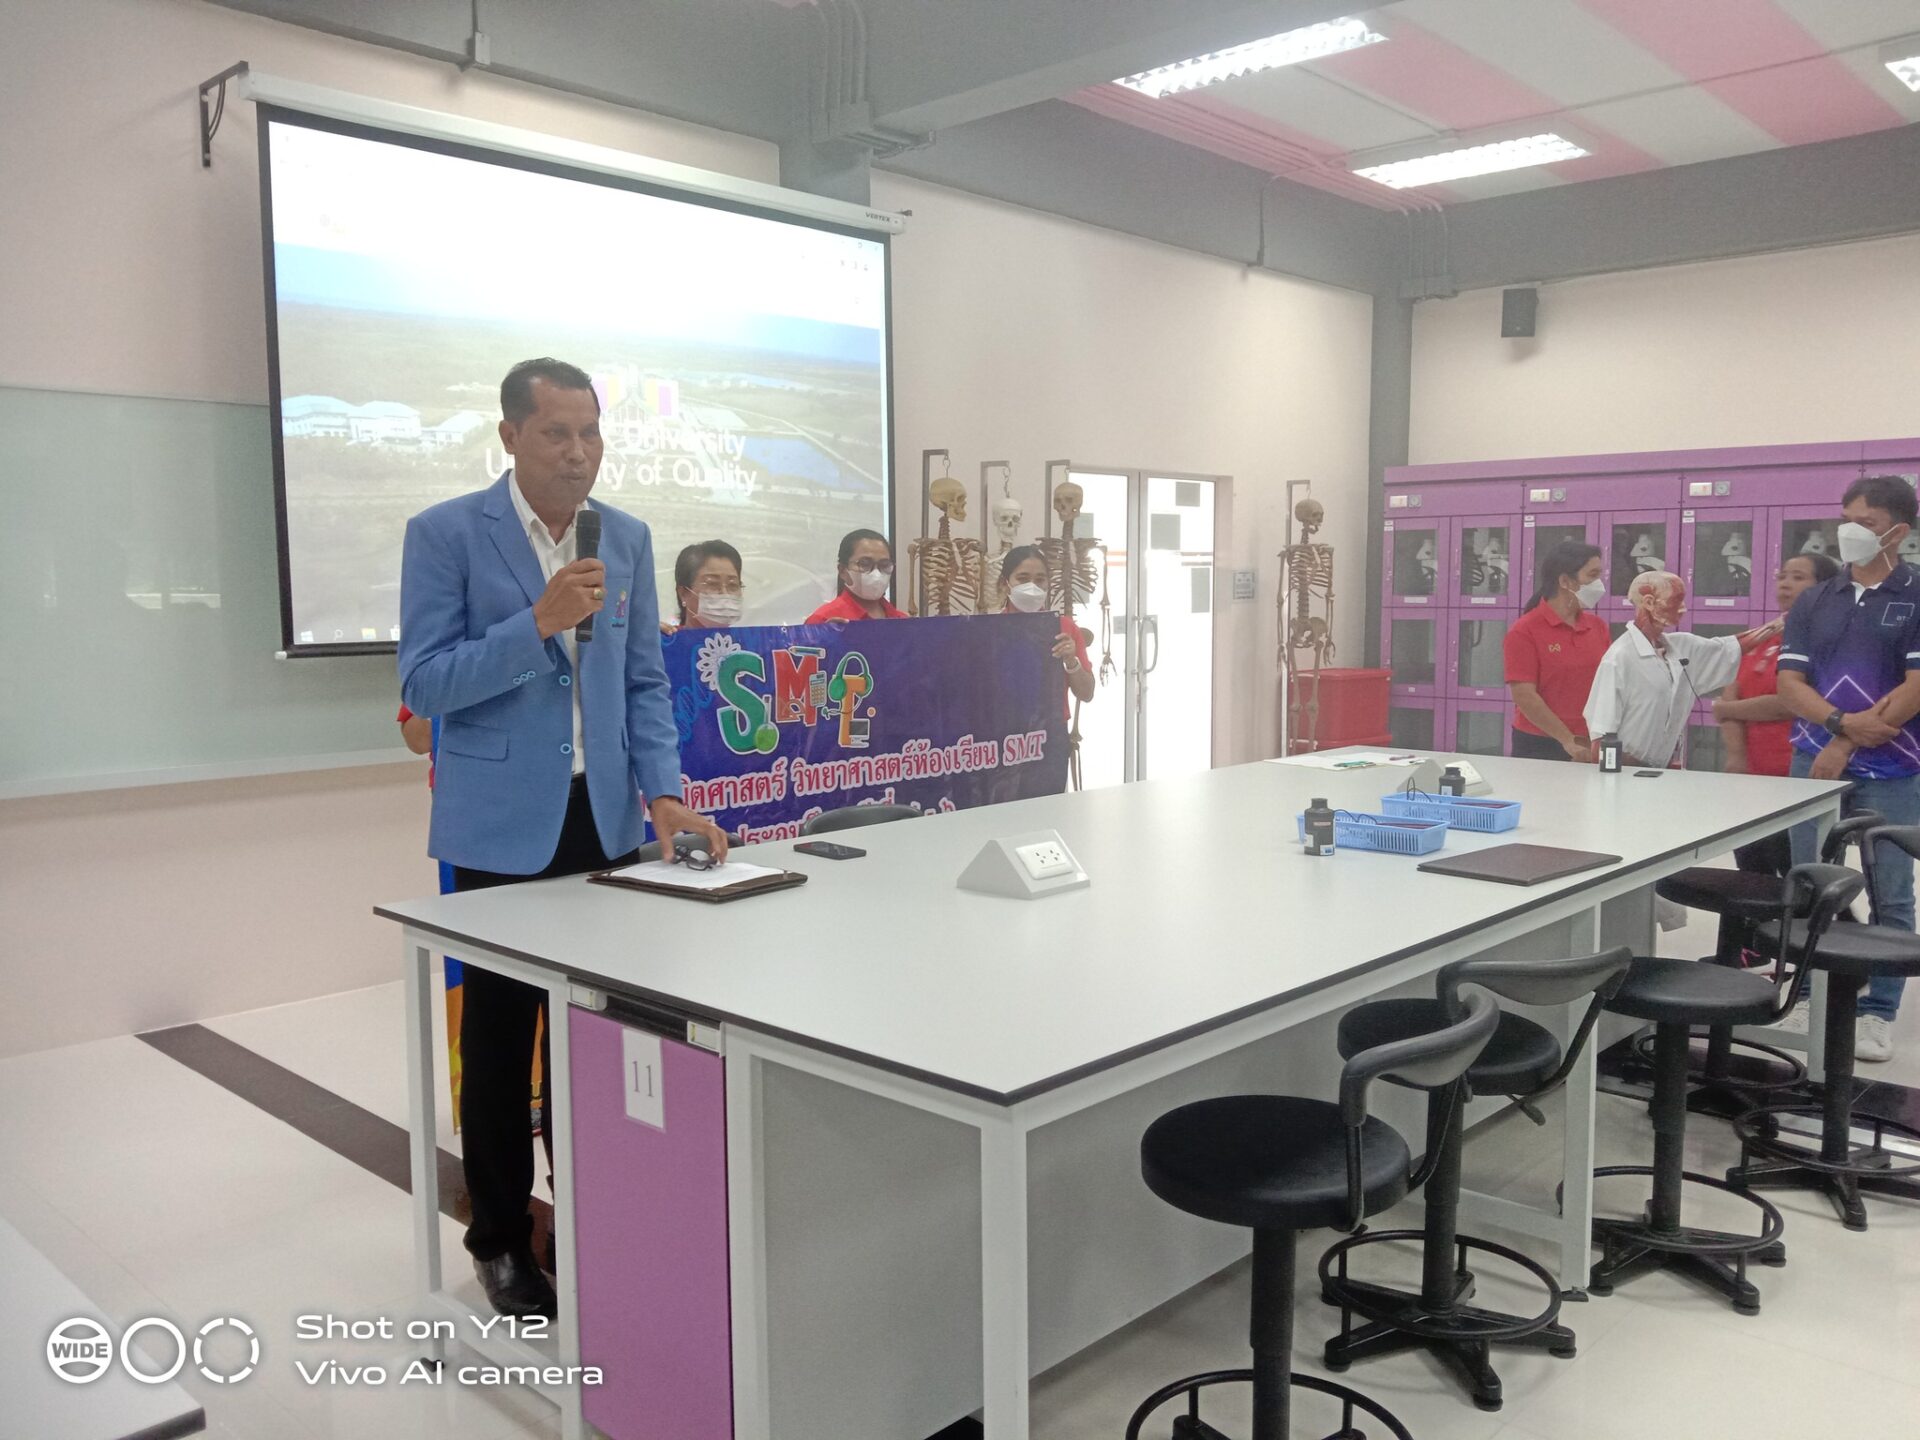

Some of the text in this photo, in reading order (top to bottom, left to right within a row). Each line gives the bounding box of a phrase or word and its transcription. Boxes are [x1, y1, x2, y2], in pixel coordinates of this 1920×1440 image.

[865, 212, 890, 222] VERTEX
[635, 455, 663, 486] of
[672, 457, 758, 497] Quality
[1004, 731, 1046, 765] SMT
[632, 1060, 654, 1098] 11
